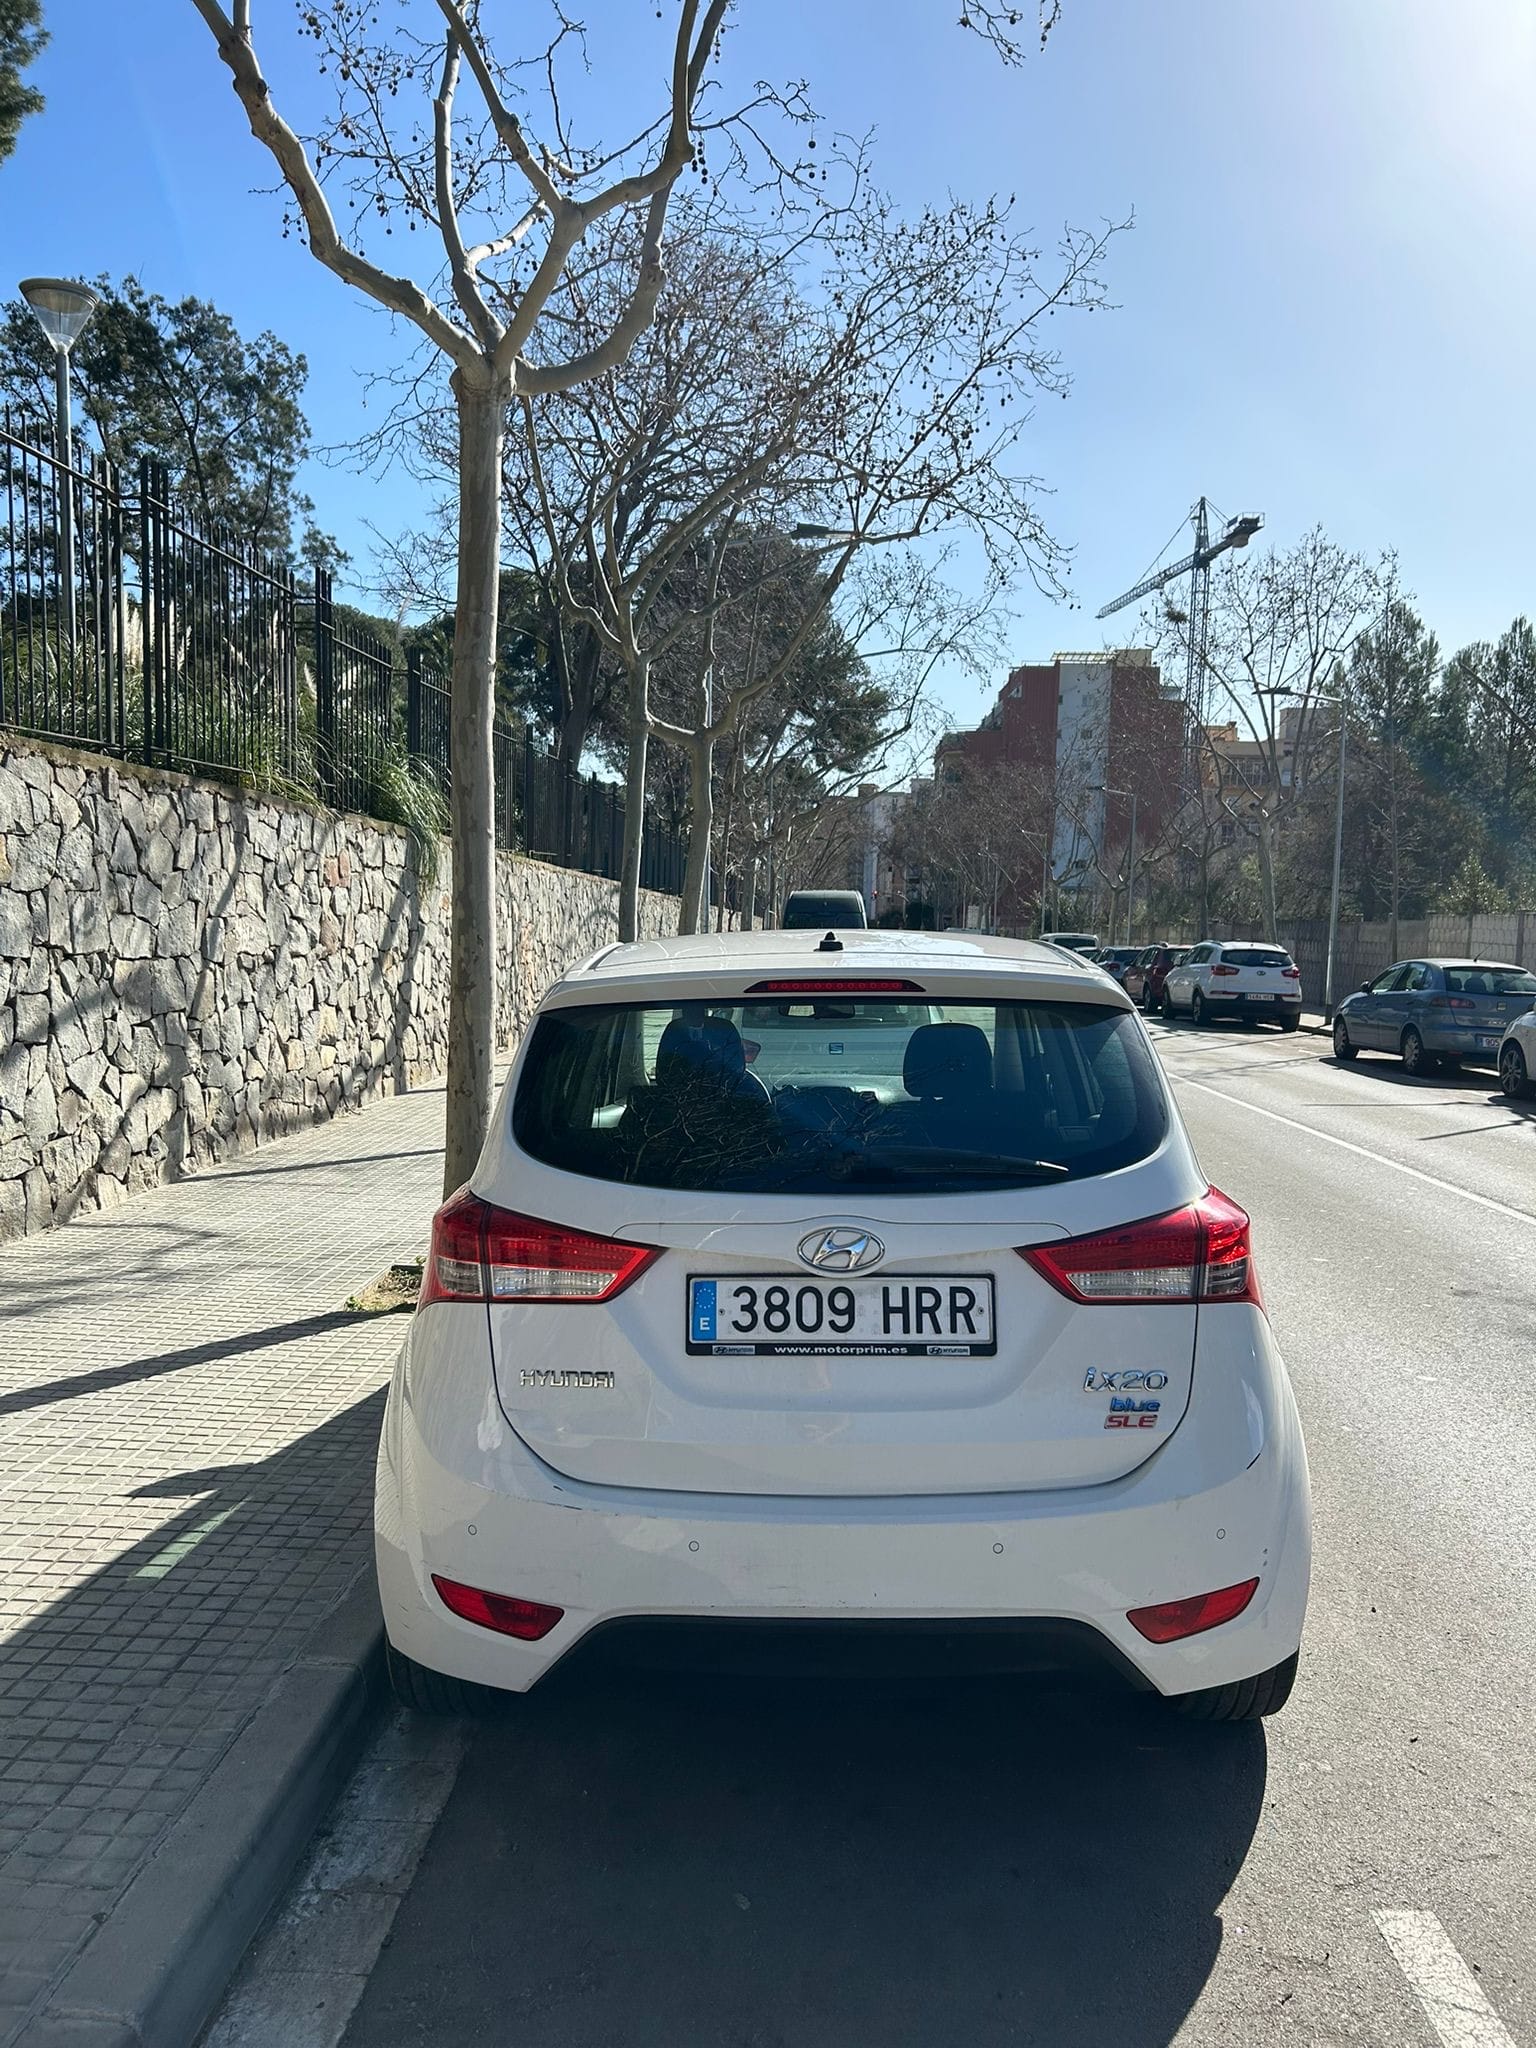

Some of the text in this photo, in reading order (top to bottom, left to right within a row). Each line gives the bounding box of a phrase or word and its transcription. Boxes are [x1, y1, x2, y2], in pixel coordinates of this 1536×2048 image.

[731, 1286, 977, 1334] 3809 HRR
[700, 1318, 710, 1330] E
[774, 1345, 908, 1355] www.motorprim.es
[520, 1369, 615, 1388] HYUNDAI
[1083, 1366, 1168, 1392] ix20
[1110, 1396, 1161, 1413] blue
[1104, 1414, 1158, 1429] SLE
